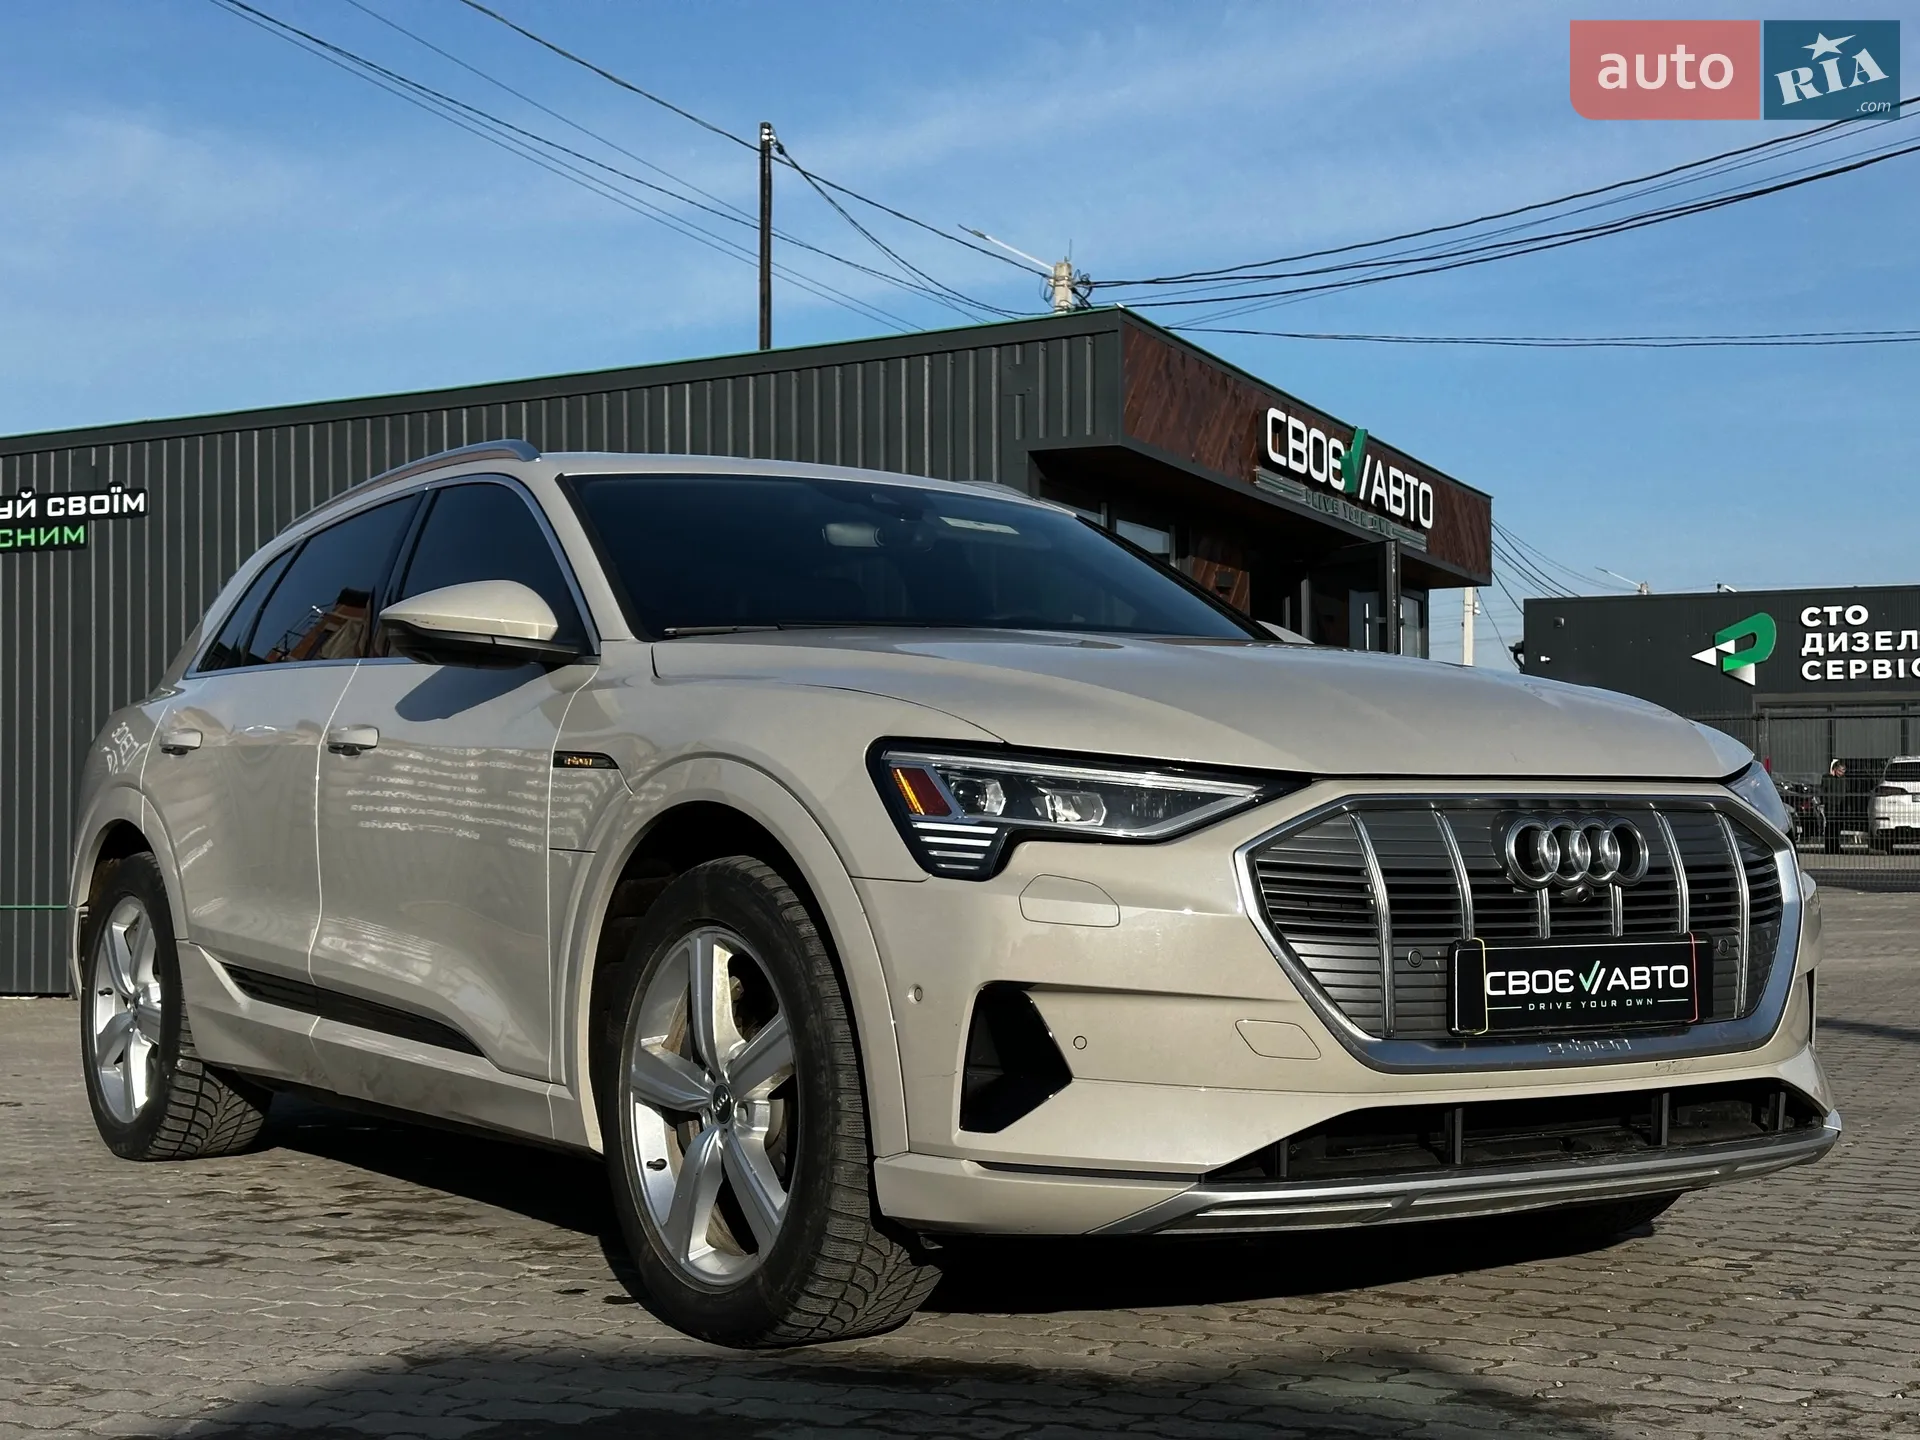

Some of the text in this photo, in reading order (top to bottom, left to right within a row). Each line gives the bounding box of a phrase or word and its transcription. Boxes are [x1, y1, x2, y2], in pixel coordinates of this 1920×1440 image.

[1371, 459, 1434, 530] АВТО
[1800, 604, 1869, 628] СТО
[1800, 629, 1918, 657] ДИЗЕЛ
[1606, 964, 1690, 992] АВТО
[1528, 997, 1654, 1011] DRIVE YOUR OWN
